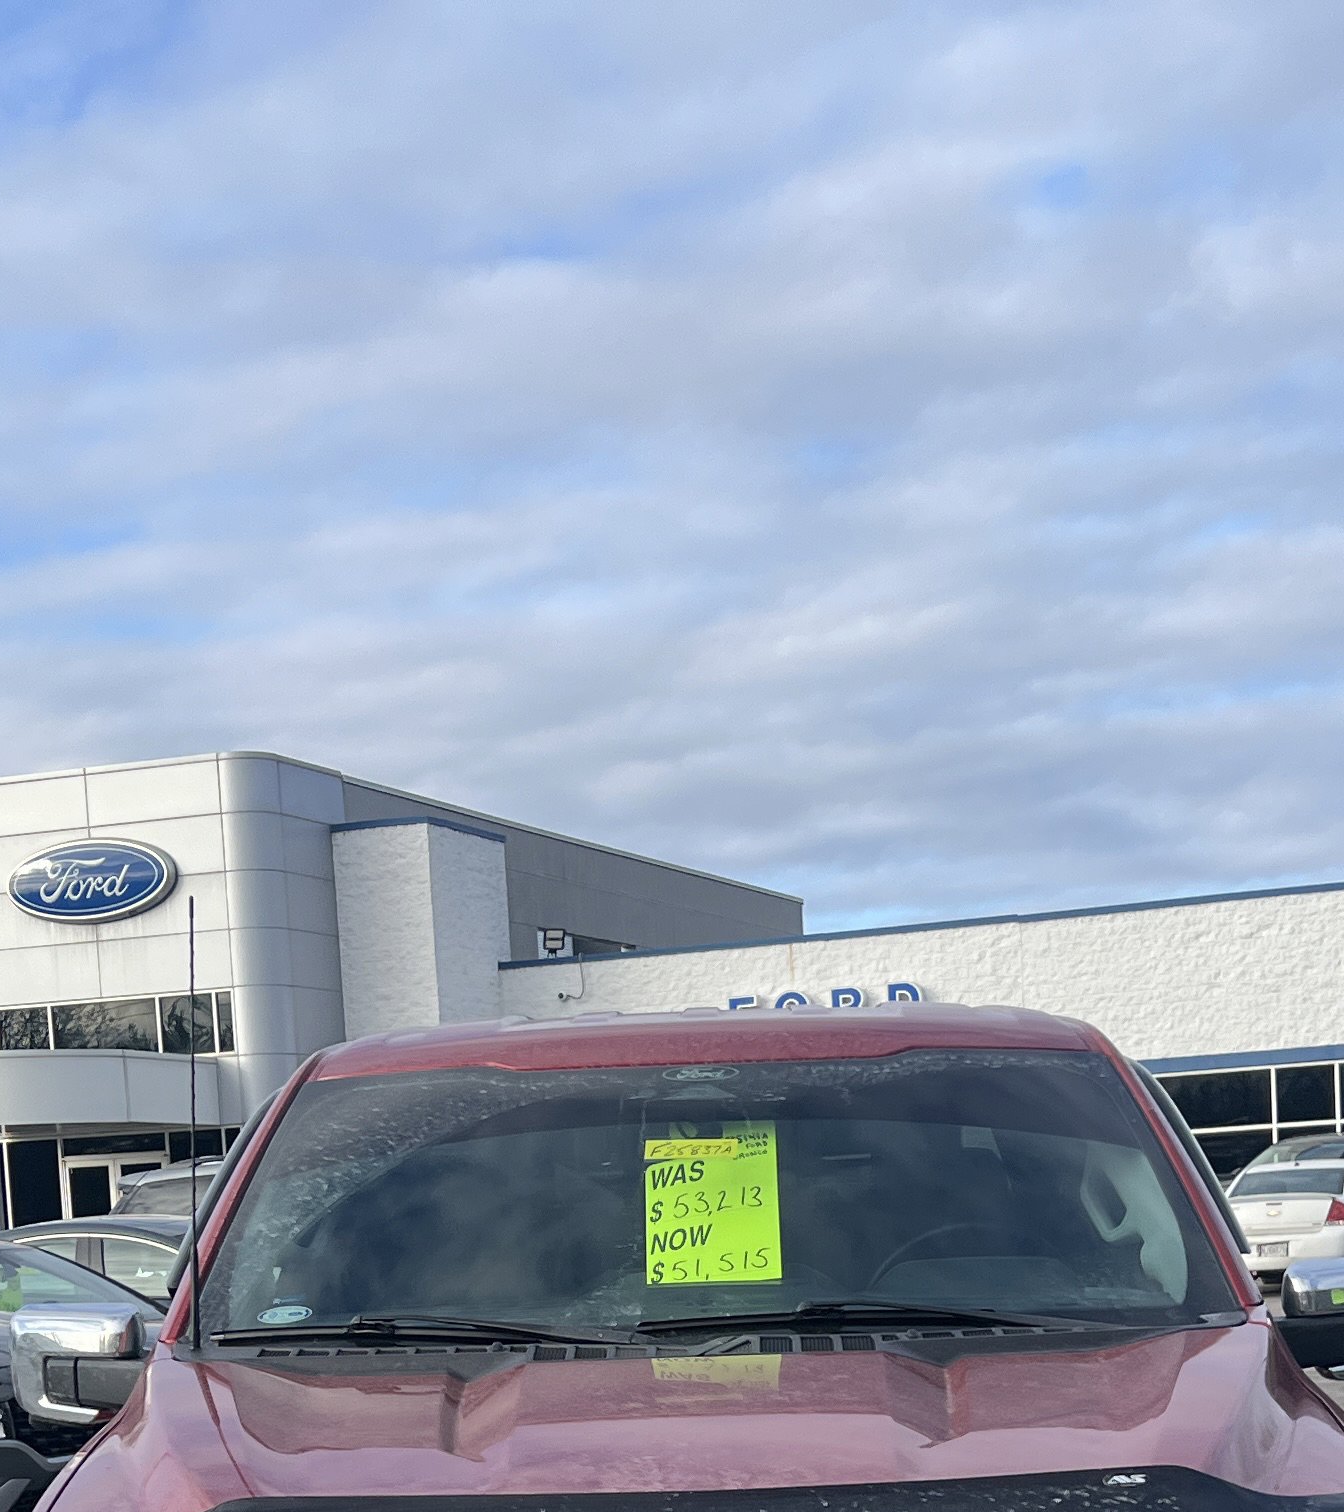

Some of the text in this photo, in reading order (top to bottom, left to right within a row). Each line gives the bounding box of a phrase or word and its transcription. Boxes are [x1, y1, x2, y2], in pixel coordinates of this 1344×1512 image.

[39, 856, 130, 904] Ford
[651, 1160, 705, 1190] WAS
[650, 1223, 713, 1255] NOW
